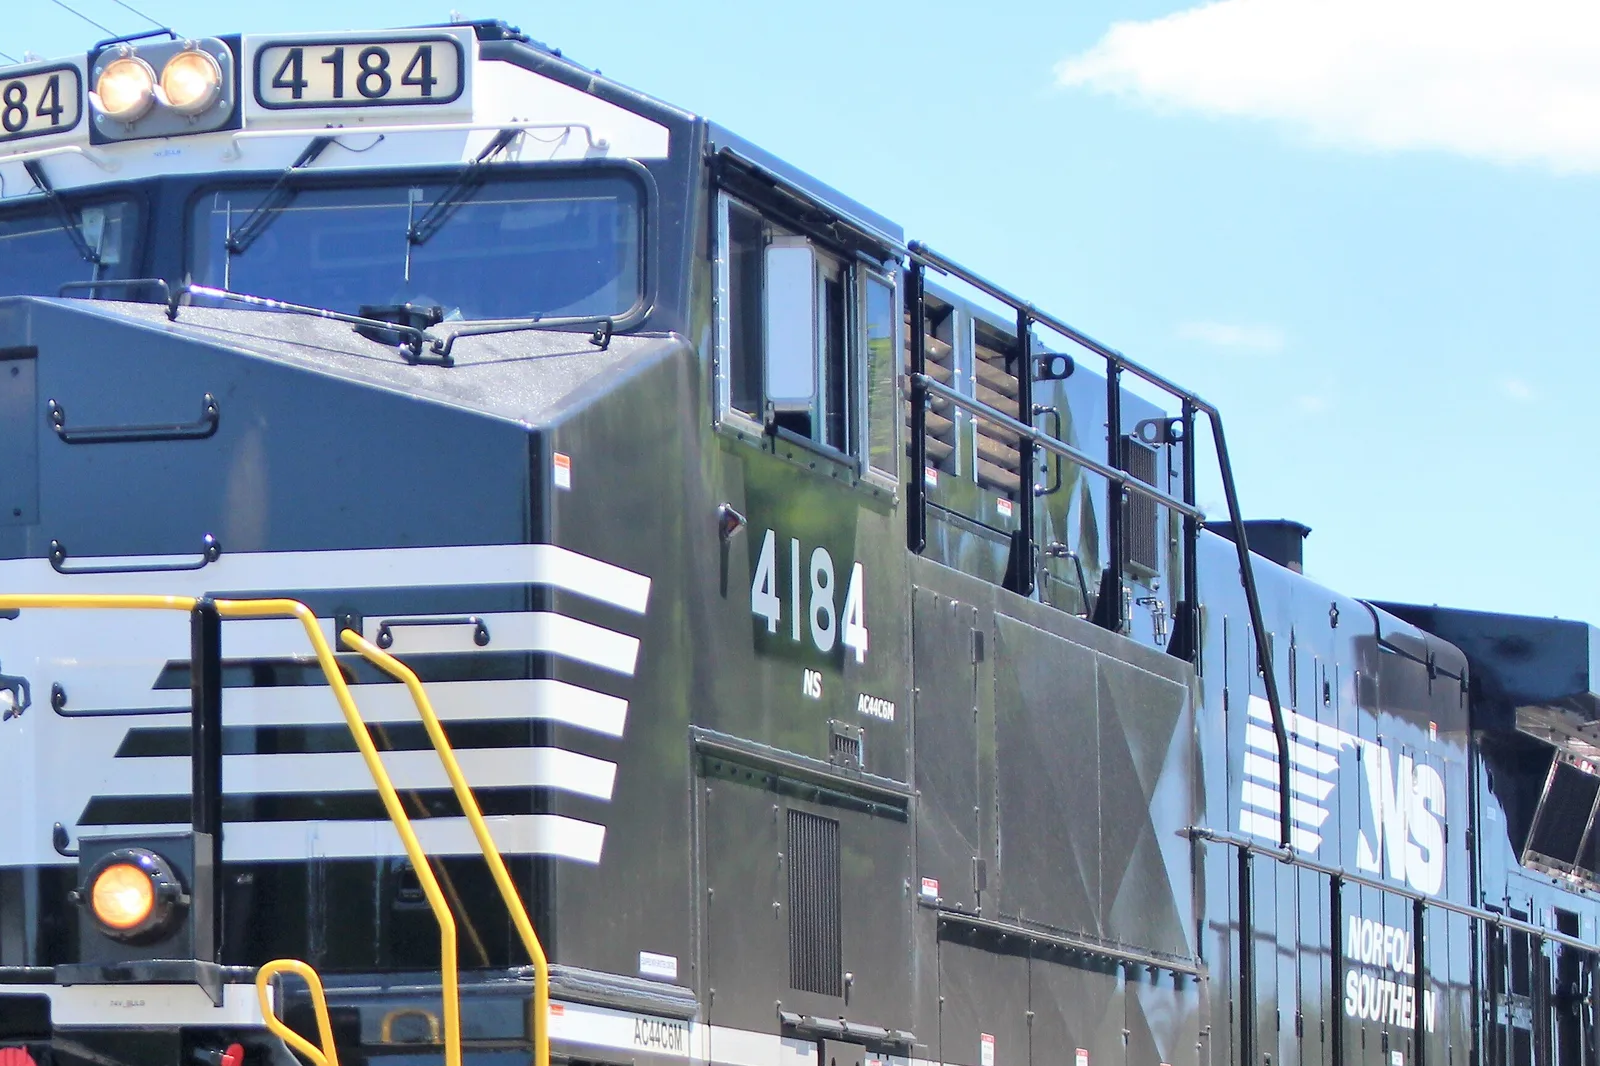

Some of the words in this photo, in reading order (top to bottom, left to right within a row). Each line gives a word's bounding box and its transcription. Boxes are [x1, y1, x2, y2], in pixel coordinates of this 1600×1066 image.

[271, 44, 438, 100] 4184
[751, 528, 869, 664] 4184
[803, 668, 822, 699] NS
[858, 693, 895, 721] AC44C6M
[1355, 738, 1447, 896] NS
[1348, 915, 1426, 975] NORFOL
[1345, 970, 1435, 1034] SOUTHEN
[634, 1017, 683, 1051] AC44C6M
